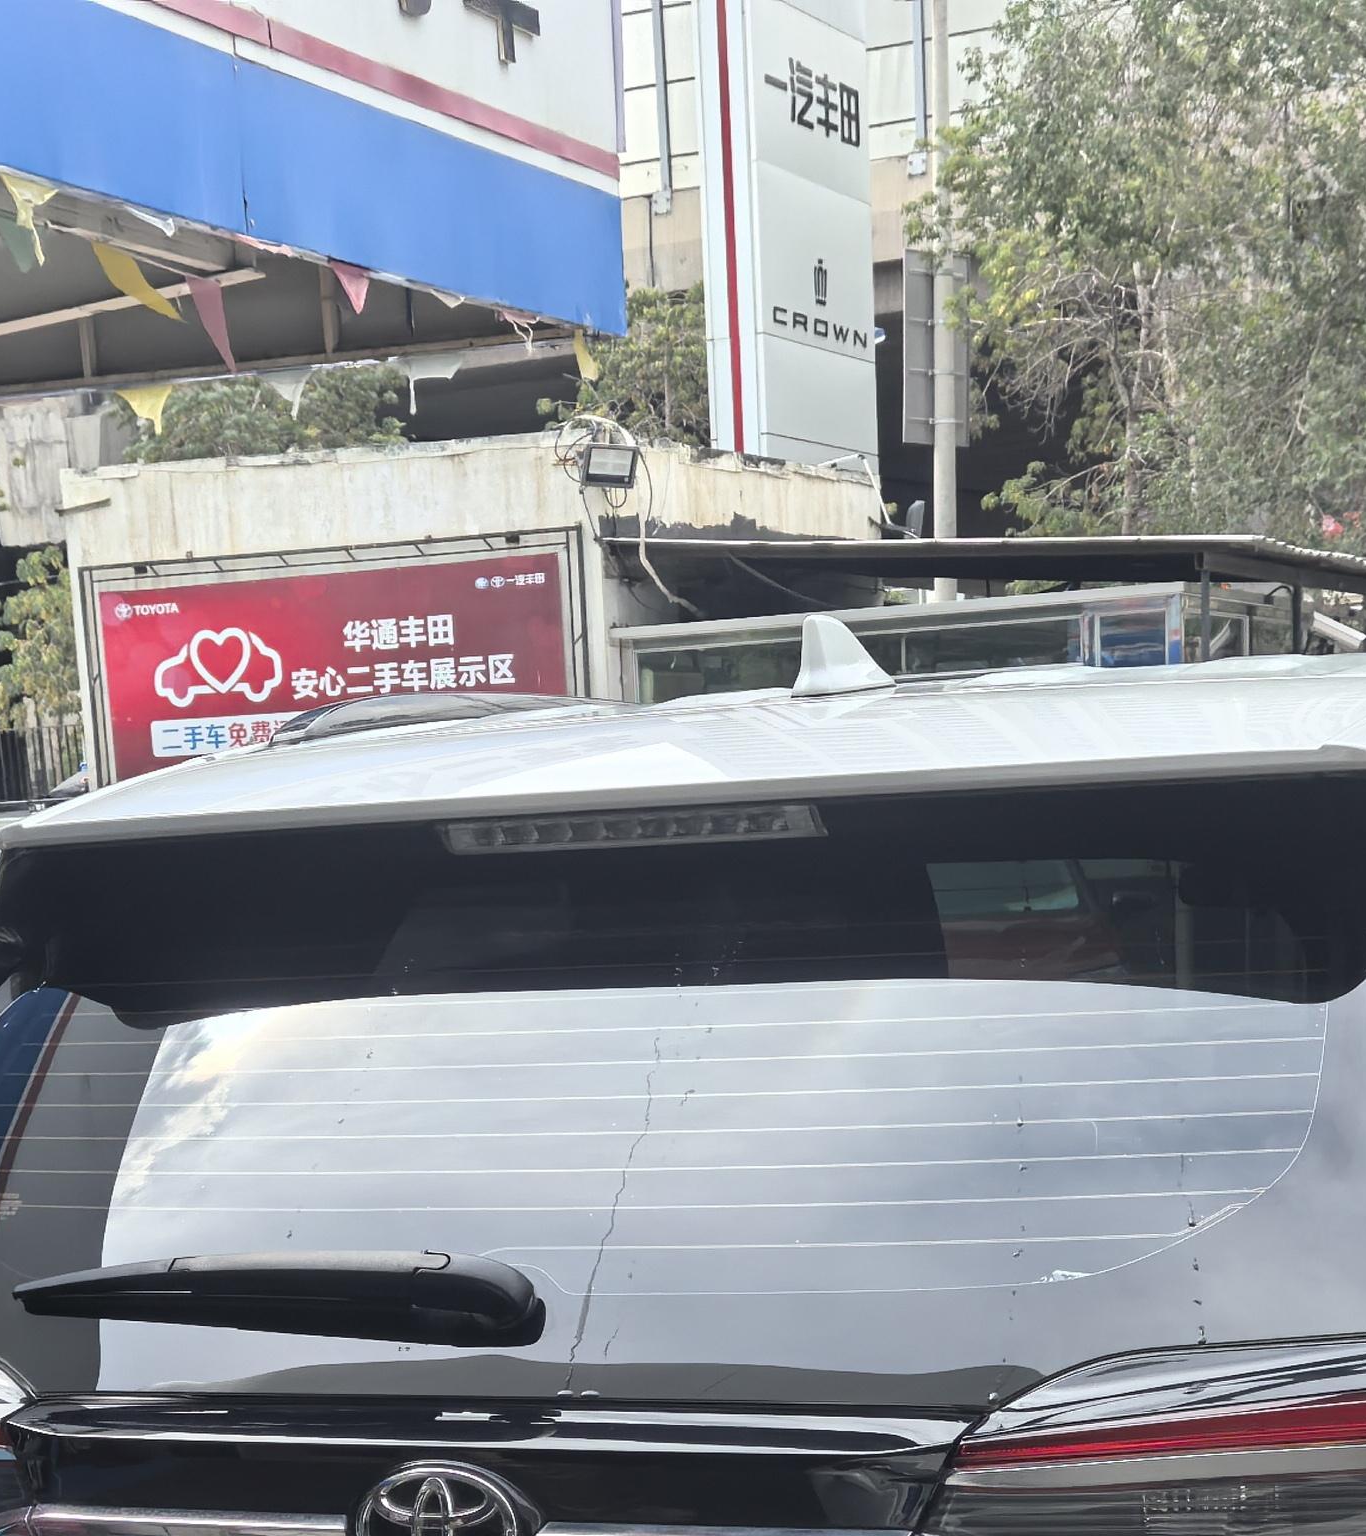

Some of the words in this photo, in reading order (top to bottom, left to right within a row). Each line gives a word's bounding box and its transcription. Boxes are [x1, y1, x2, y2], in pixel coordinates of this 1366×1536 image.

[763, 57, 861, 149] 一汽丰田
[772, 305, 869, 350] CROWN
[133, 603, 180, 616] TOYOTA
[343, 614, 455, 653] 华通丰田
[291, 654, 516, 700] 安心二手车展示区
